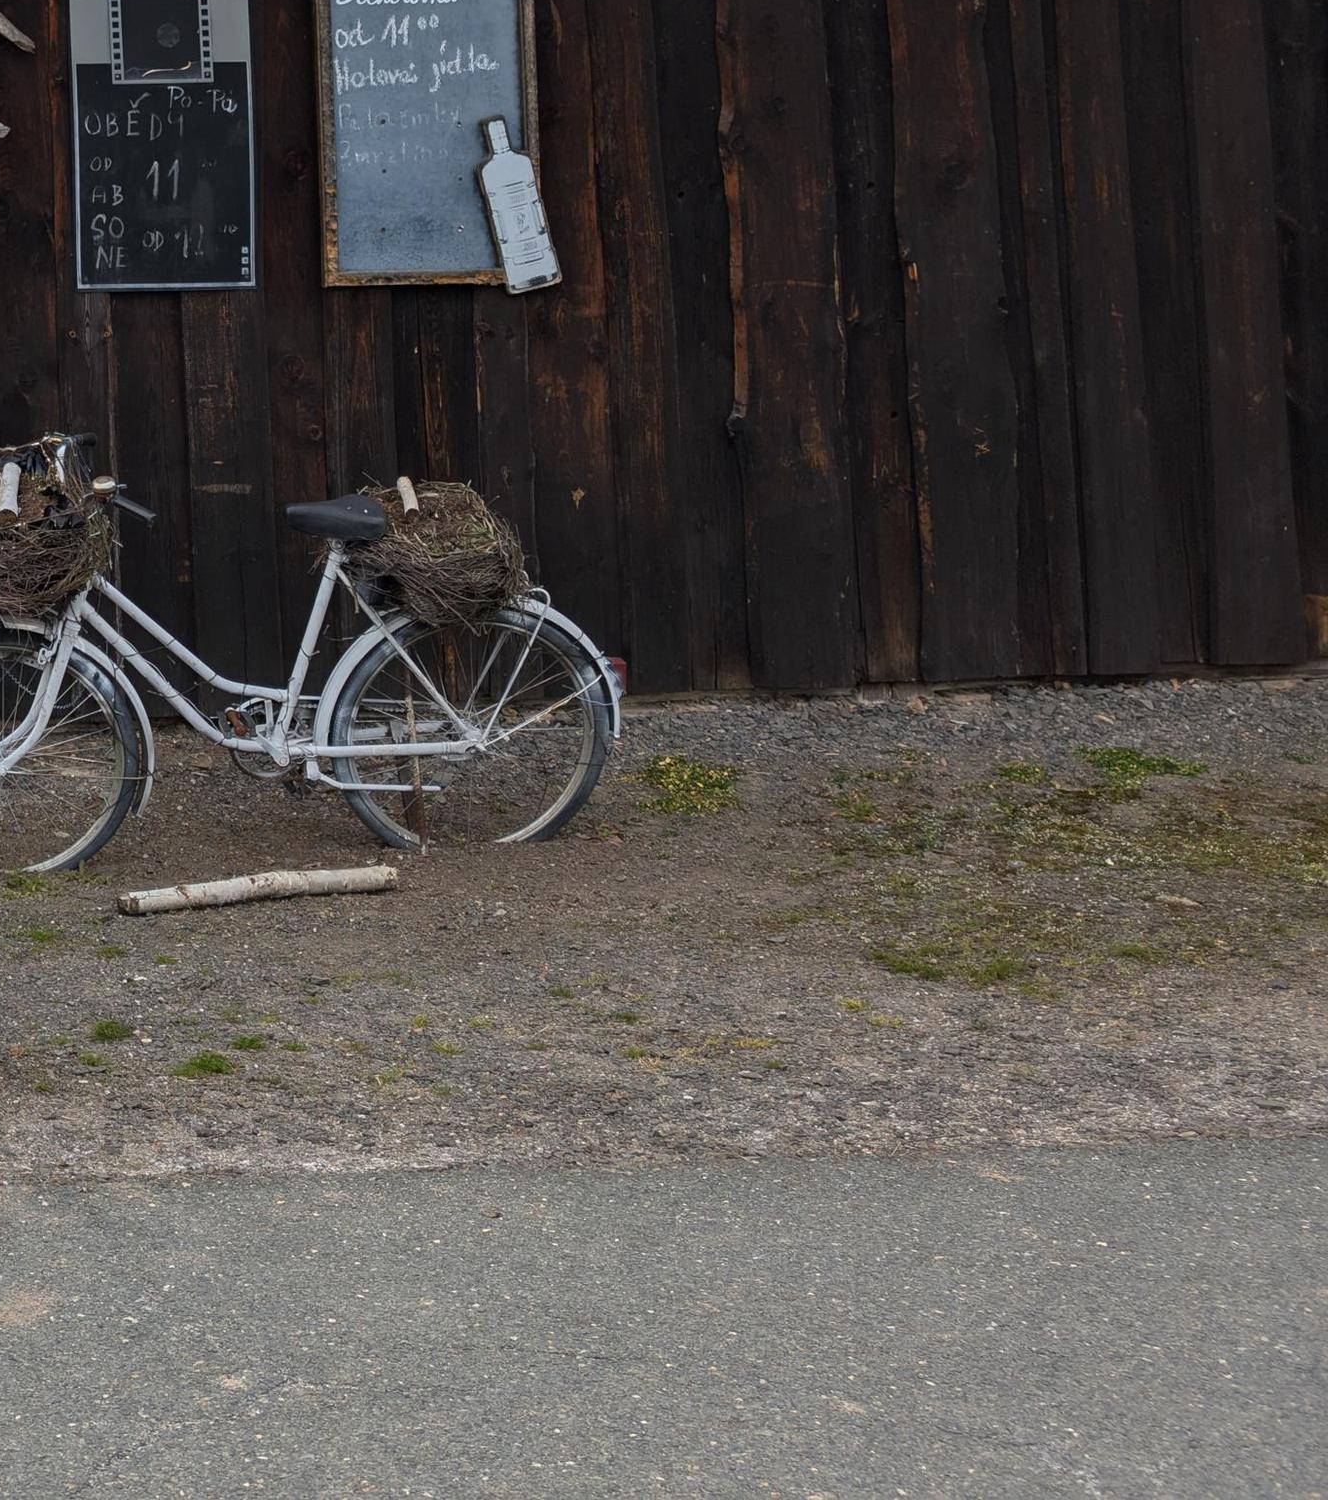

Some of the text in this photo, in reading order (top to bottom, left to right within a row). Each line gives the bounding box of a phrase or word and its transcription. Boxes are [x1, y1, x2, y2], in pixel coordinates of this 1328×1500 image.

[335, 18, 375, 48] od
[90, 156, 113, 172] OD
[92, 184, 124, 206] AB
[90, 213, 125, 239] SO
[142, 230, 164, 251] OD
[96, 245, 127, 269] NE
